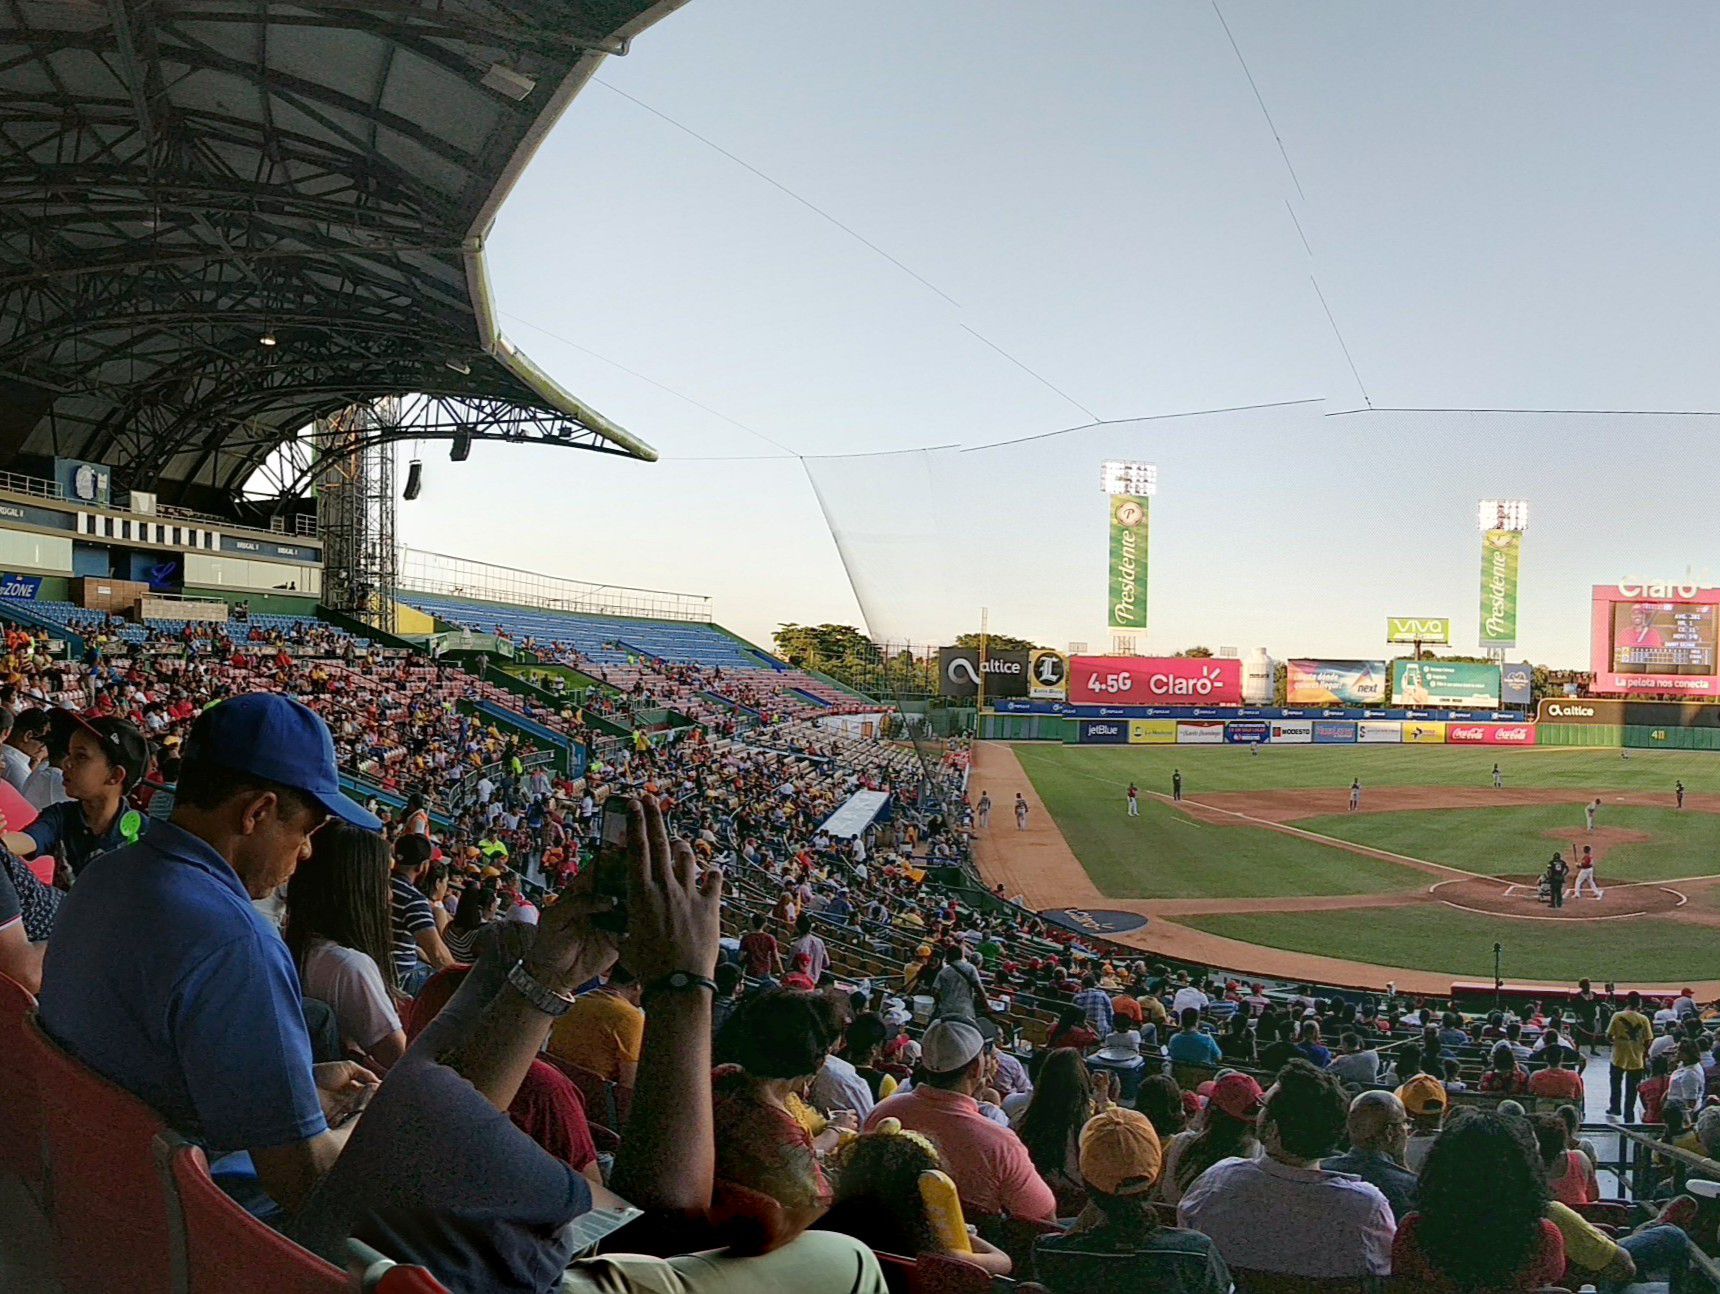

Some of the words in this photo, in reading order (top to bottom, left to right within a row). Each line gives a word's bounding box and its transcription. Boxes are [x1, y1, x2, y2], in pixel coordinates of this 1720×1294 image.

[1115, 530, 1136, 624] Presidente
[1618, 576, 1698, 598] Claro
[1485, 551, 1506, 637] Presidente
[980, 659, 1021, 674] altice
[1087, 672, 1132, 693] 4.5G
[1150, 671, 1213, 695] Claro
[1358, 684, 1378, 693] next
[1628, 678, 1655, 689] pelota
[1657, 680, 1672, 688] nos
[1674, 679, 1709, 688] conecta
[1564, 706, 1594, 717] altice
[1088, 724, 1118, 736] jetBlue
[1452, 728, 1485, 740] Coca-Cola
[1495, 728, 1529, 740] Coca-Cola
[1651, 730, 1665, 740] 411
